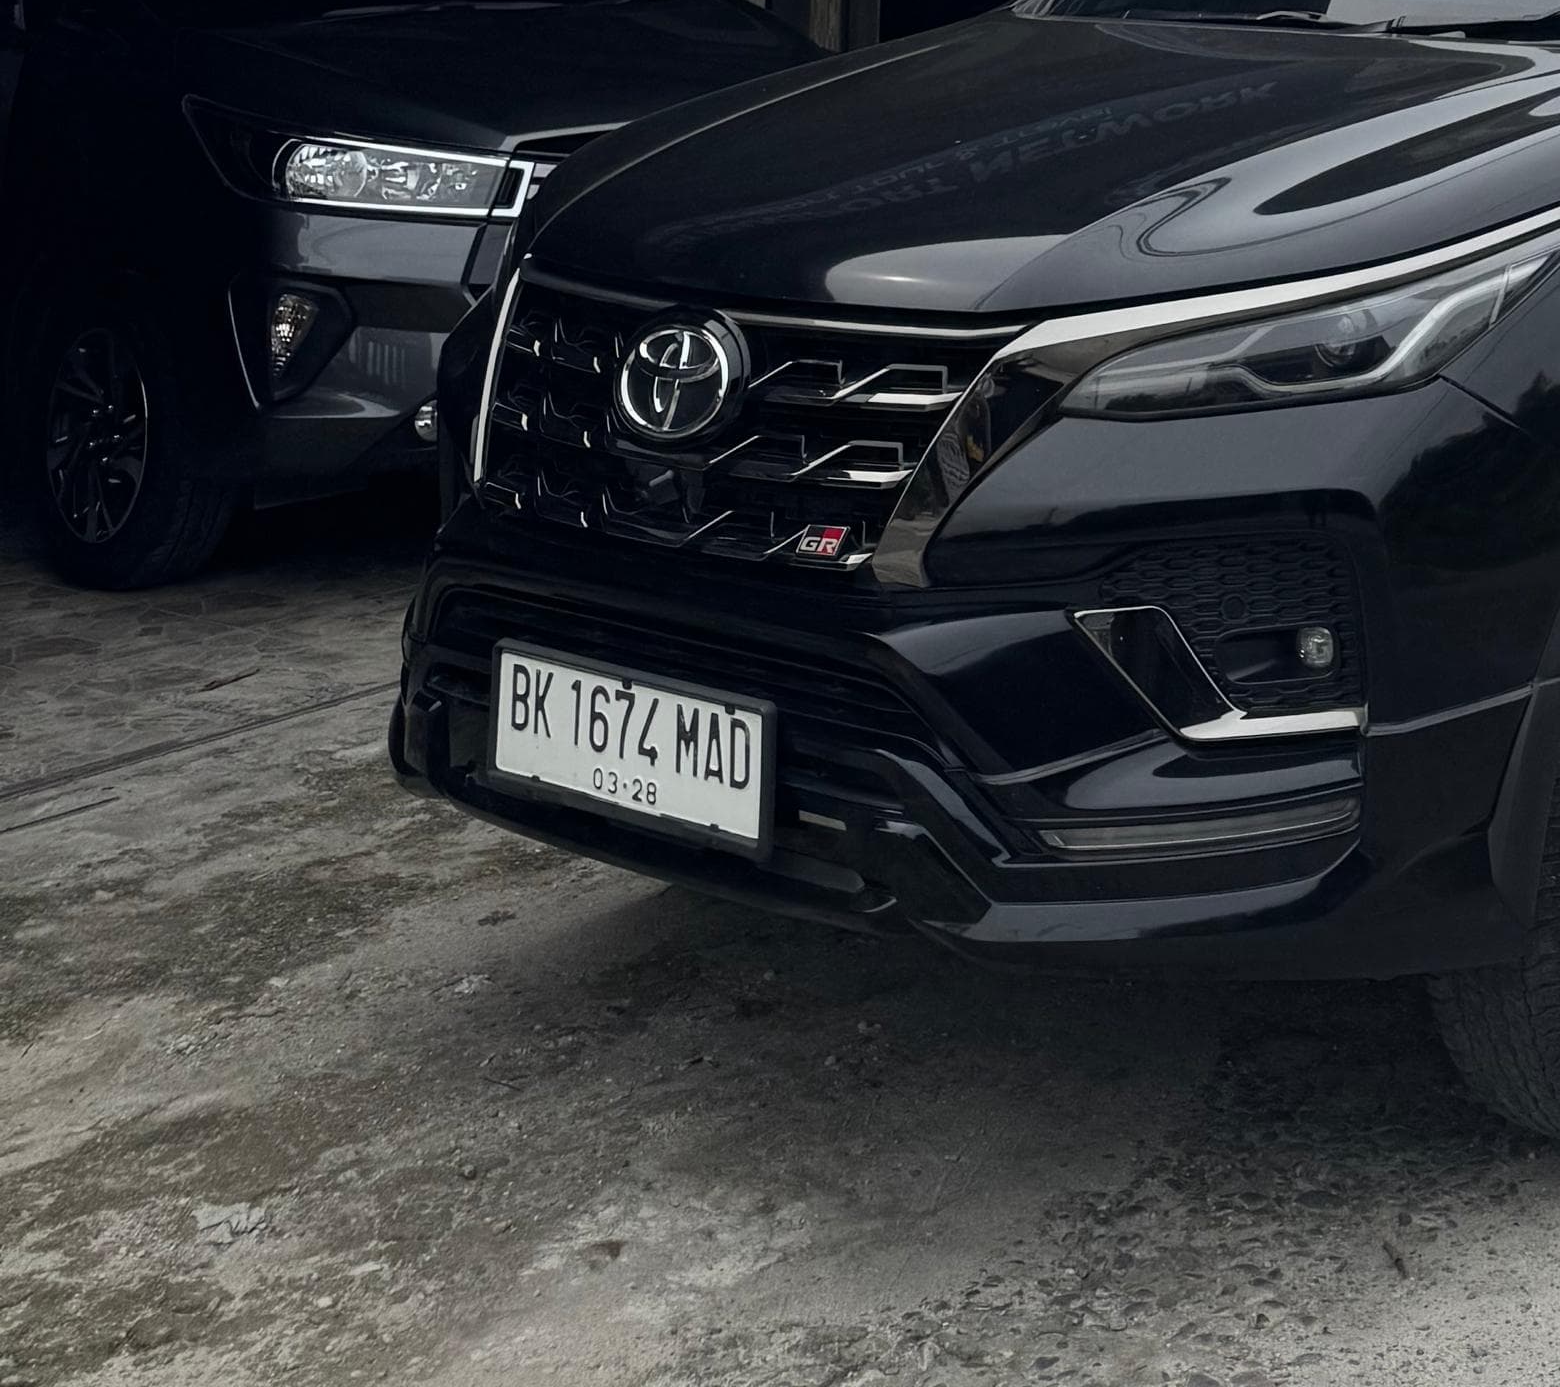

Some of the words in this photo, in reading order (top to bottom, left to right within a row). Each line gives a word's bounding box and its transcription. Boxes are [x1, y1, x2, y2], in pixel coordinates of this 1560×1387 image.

[799, 535, 838, 556] GR
[512, 663, 554, 739] BK
[571, 678, 659, 767] 1674
[675, 701, 751, 791] MAD
